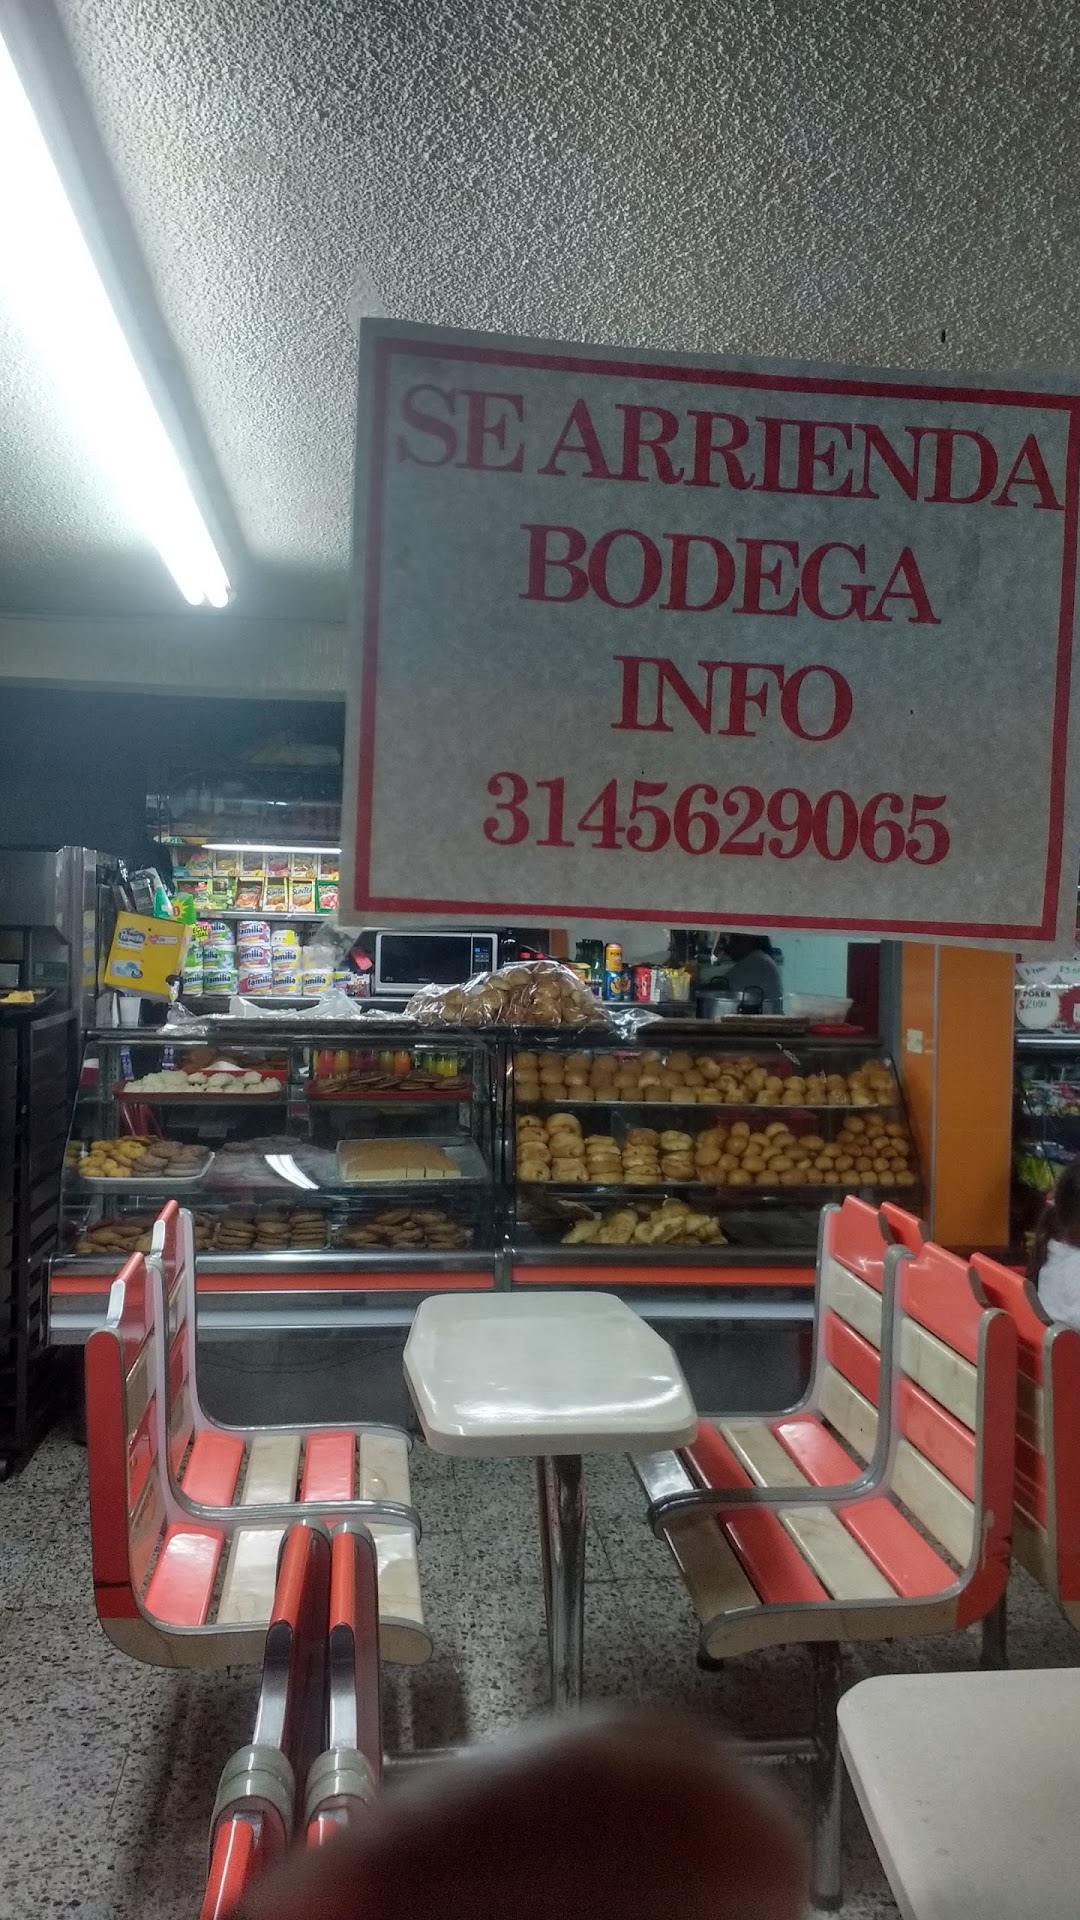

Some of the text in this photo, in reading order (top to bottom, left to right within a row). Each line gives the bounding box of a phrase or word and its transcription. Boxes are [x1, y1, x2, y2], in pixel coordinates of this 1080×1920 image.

[399, 382, 1064, 511] SE ARRIENDA
[518, 522, 941, 624] BODEGA
[611, 654, 853, 741] INFO
[482, 771, 950, 864] 3145629065
[1022, 990, 1051, 998] POKER
